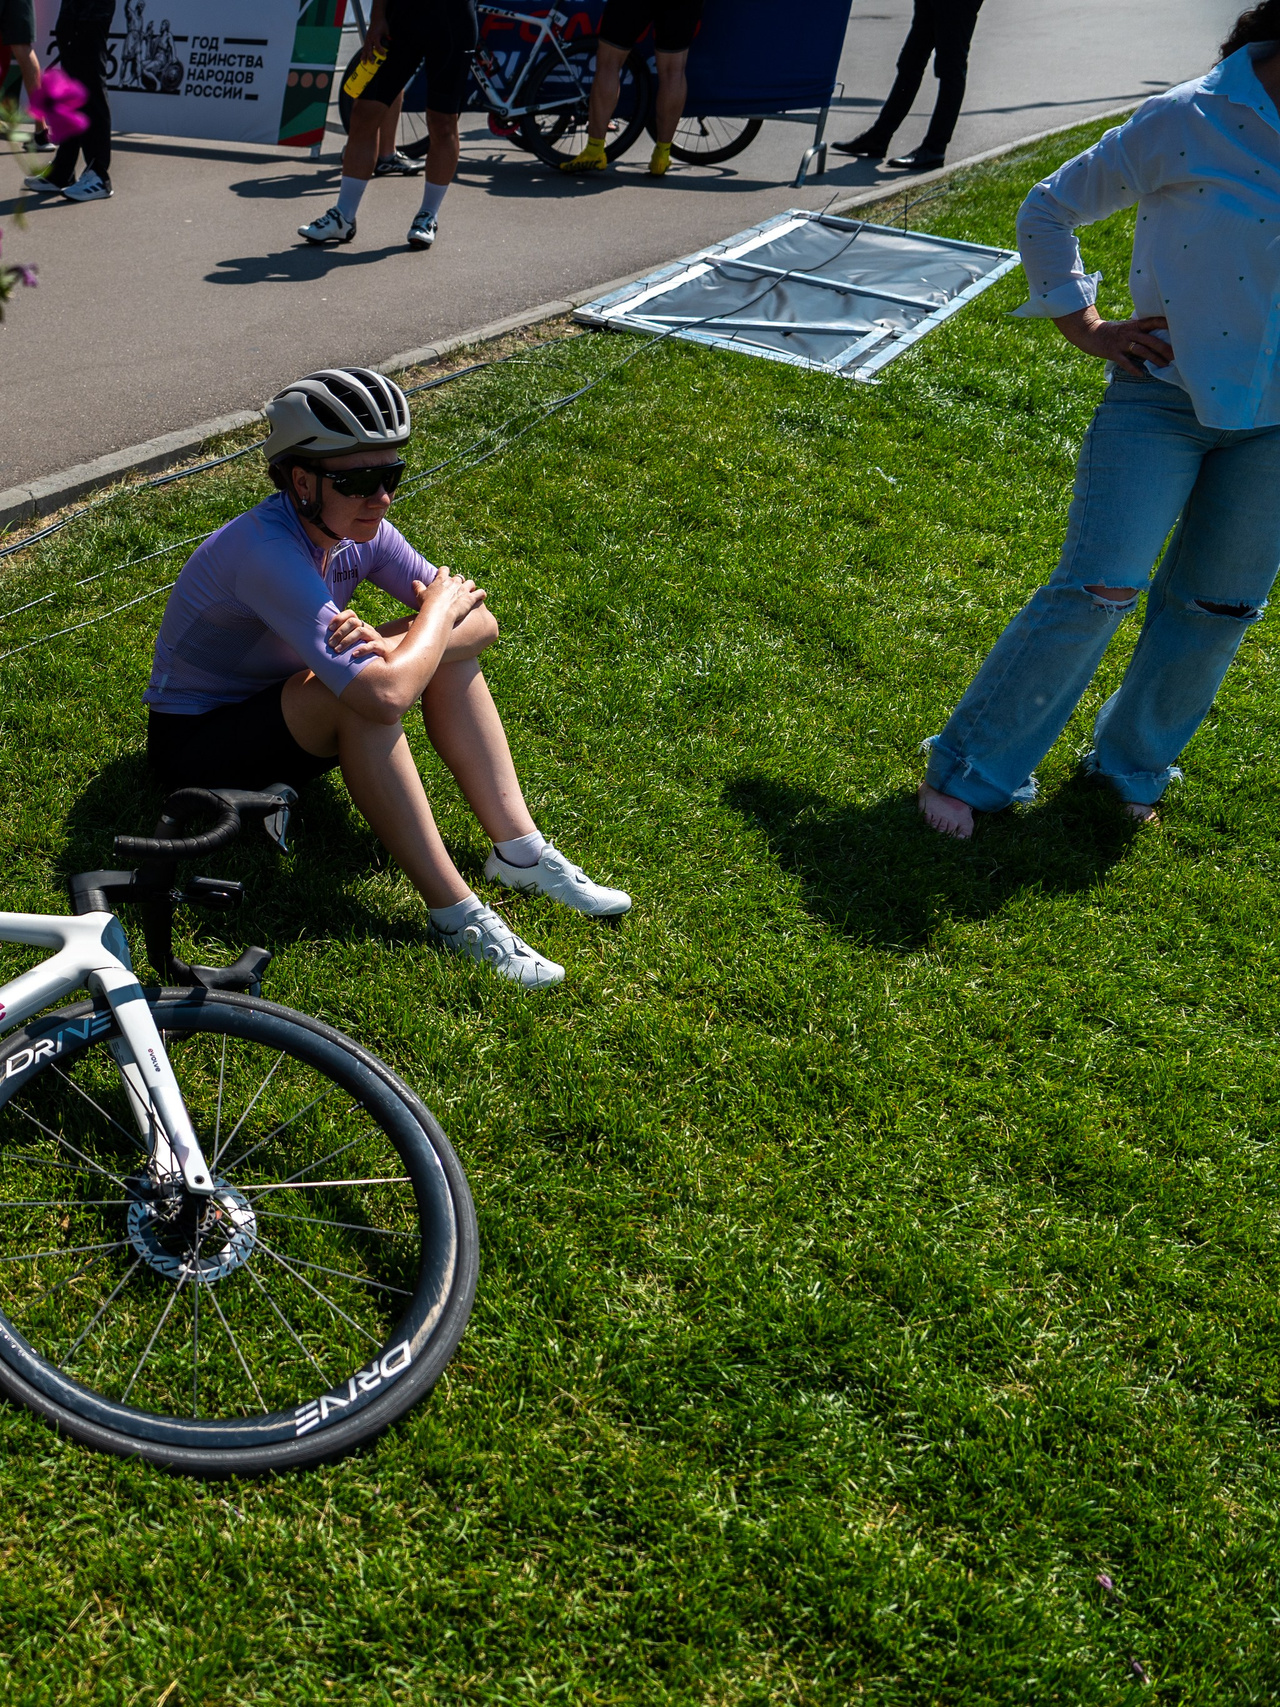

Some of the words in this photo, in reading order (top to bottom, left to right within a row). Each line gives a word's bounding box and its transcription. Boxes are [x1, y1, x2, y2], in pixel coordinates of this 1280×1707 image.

[192, 36, 219, 51] ГОД
[189, 53, 263, 68] ЕДИНСТВА
[187, 68, 254, 84] НАРОДОВ
[185, 84, 243, 99] РОССИИ
[6, 1009, 111, 1078] DRIVE
[148, 1048, 161, 1072] evolve
[294, 1339, 411, 1437] DRIVE
